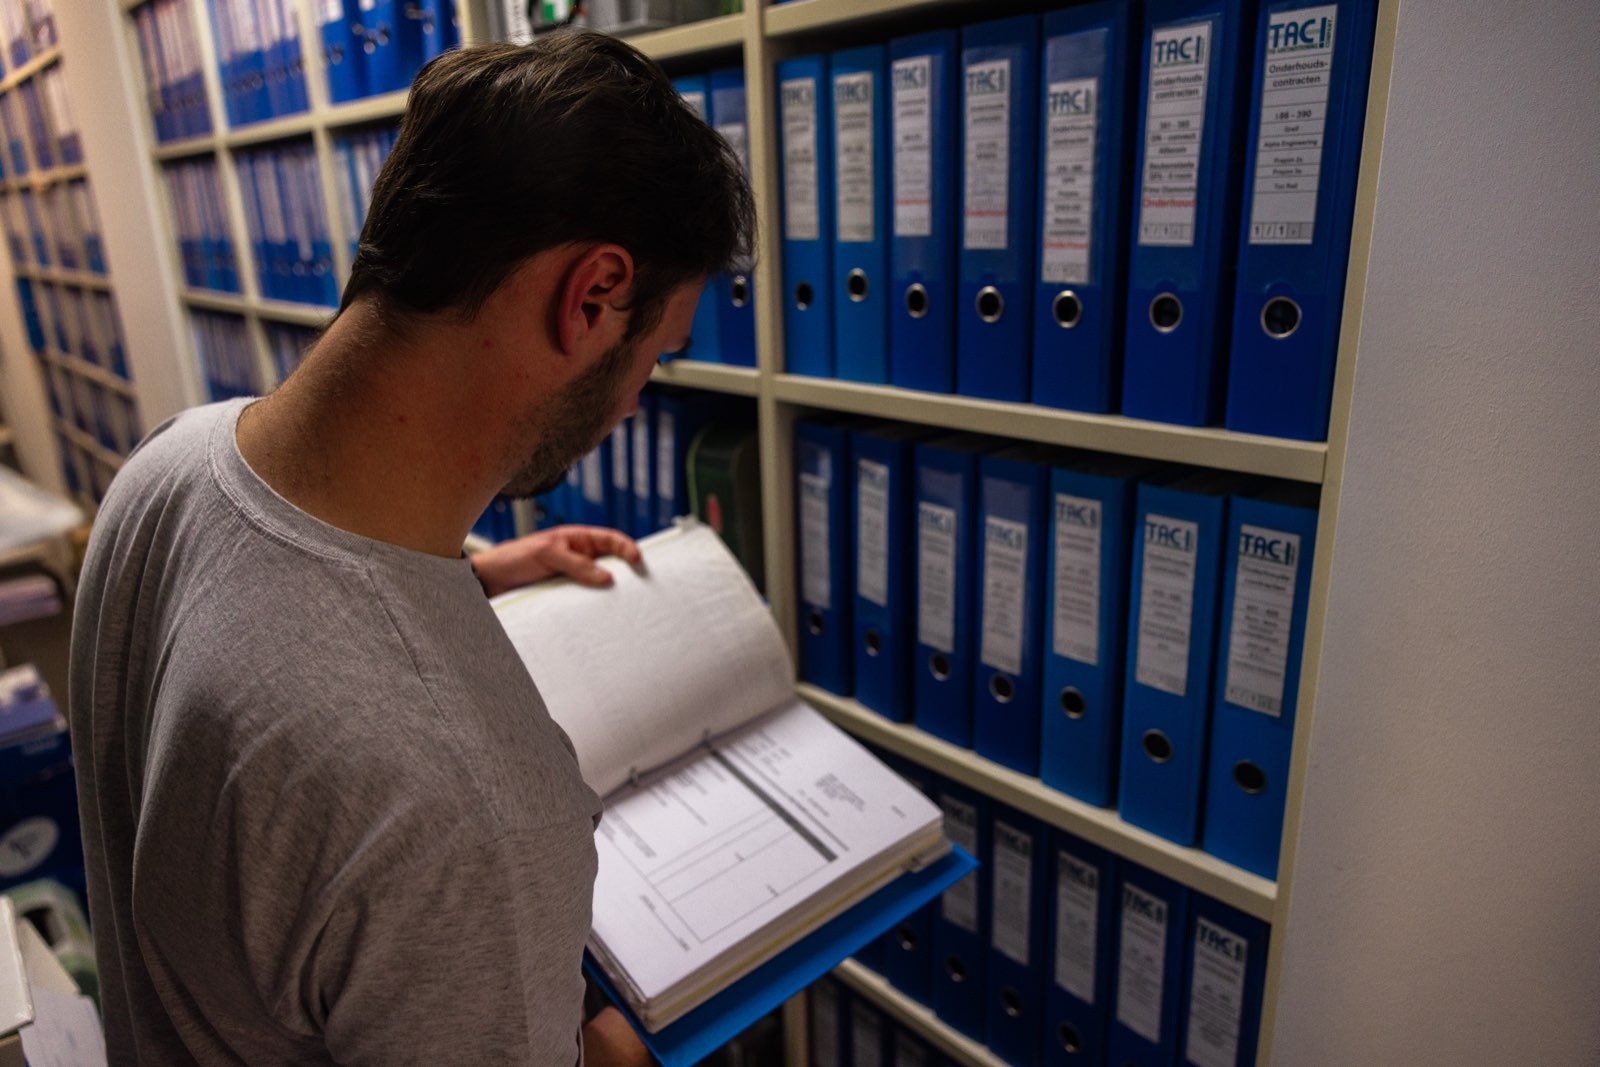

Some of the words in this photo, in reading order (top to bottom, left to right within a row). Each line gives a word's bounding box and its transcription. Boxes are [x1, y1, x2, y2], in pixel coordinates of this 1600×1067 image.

[1269, 16, 1328, 49] TAC!
[1155, 36, 1202, 64] TAC!
[1272, 76, 1321, 88] contracten
